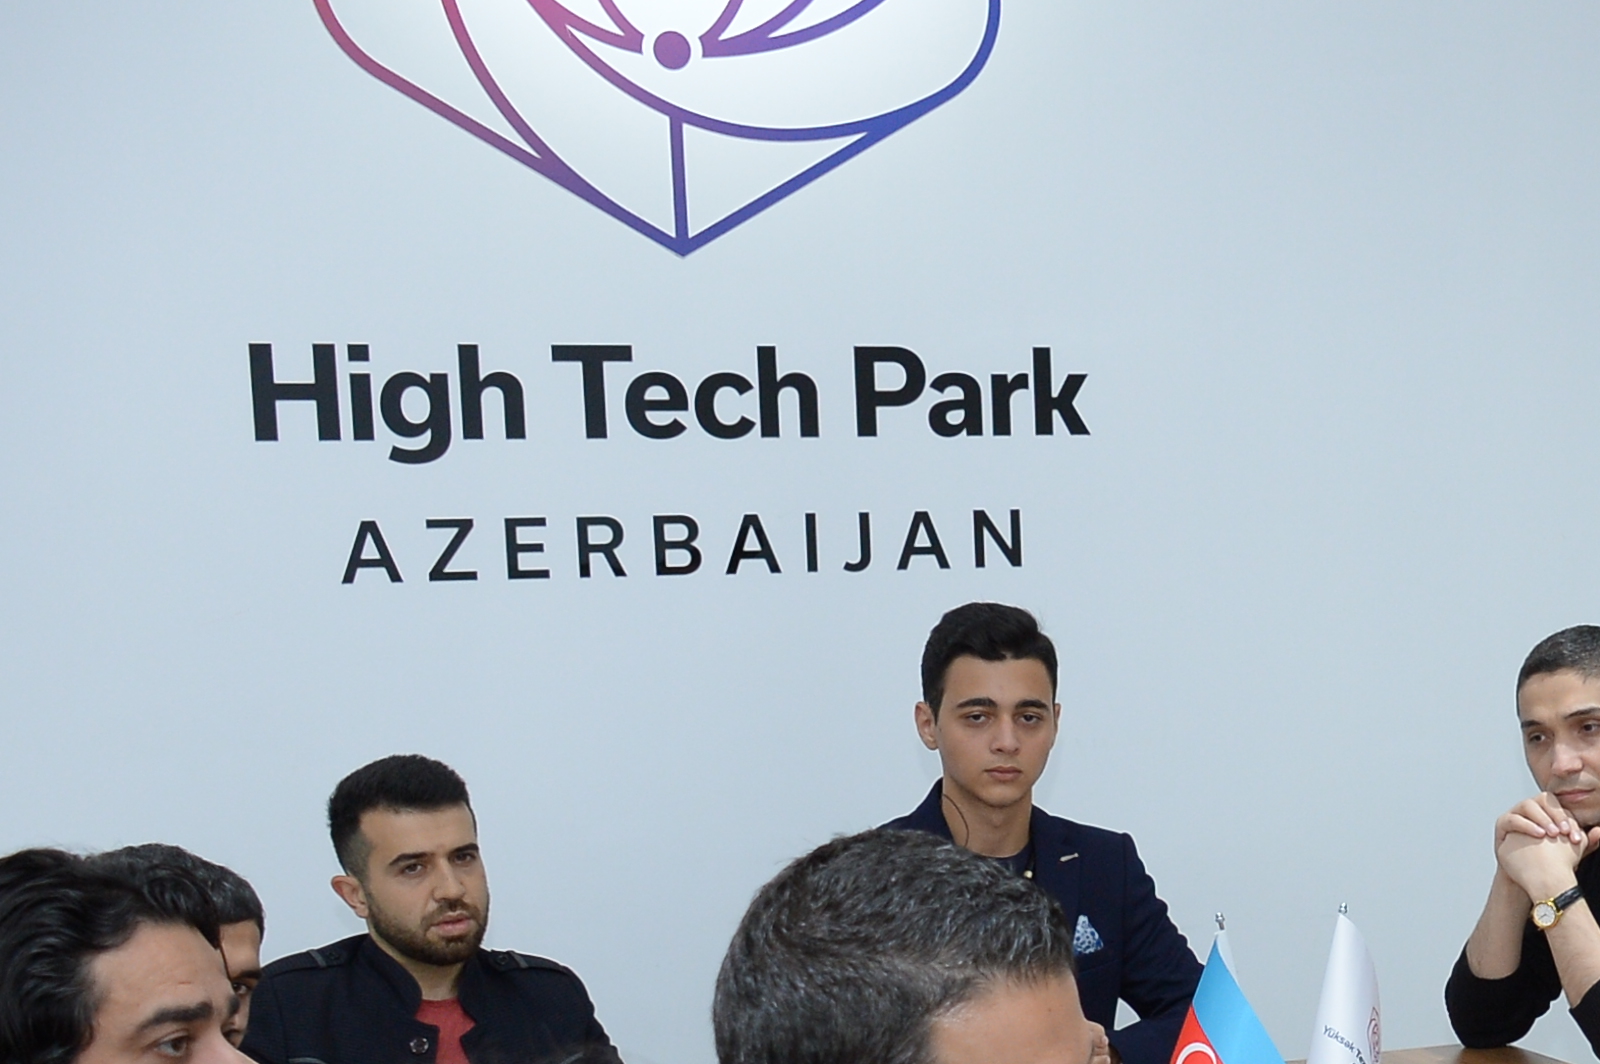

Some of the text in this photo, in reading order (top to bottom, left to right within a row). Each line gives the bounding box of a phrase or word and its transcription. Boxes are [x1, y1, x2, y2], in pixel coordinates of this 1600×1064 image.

[248, 343, 1091, 465] High Tech Park
[341, 509, 1022, 585] AZERBAIJAN
